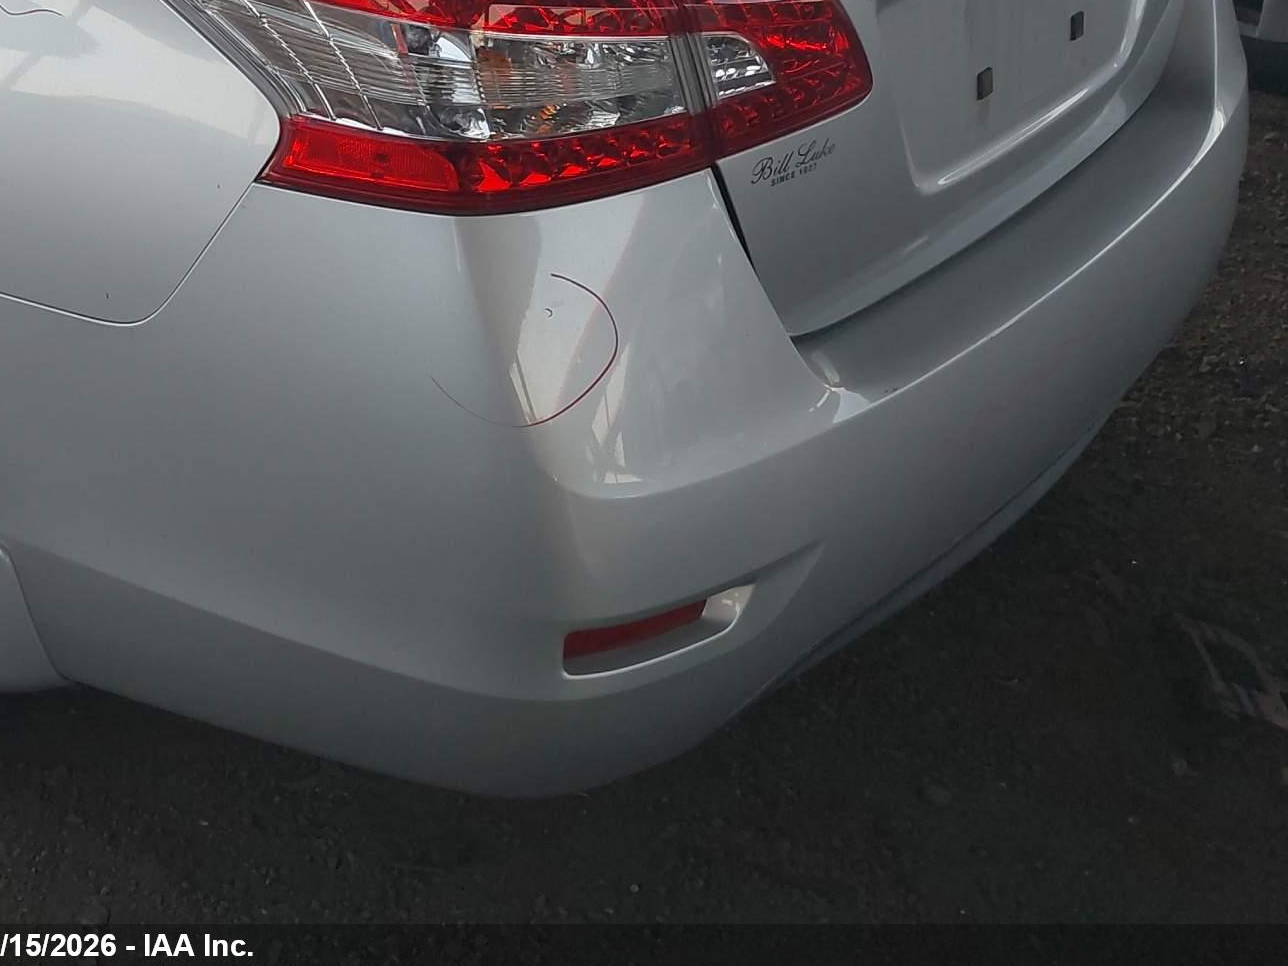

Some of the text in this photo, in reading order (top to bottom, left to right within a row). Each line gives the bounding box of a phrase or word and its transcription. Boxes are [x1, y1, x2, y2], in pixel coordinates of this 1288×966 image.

[751, 138, 836, 184] Bill Luke
[771, 171, 796, 187] SINCE
